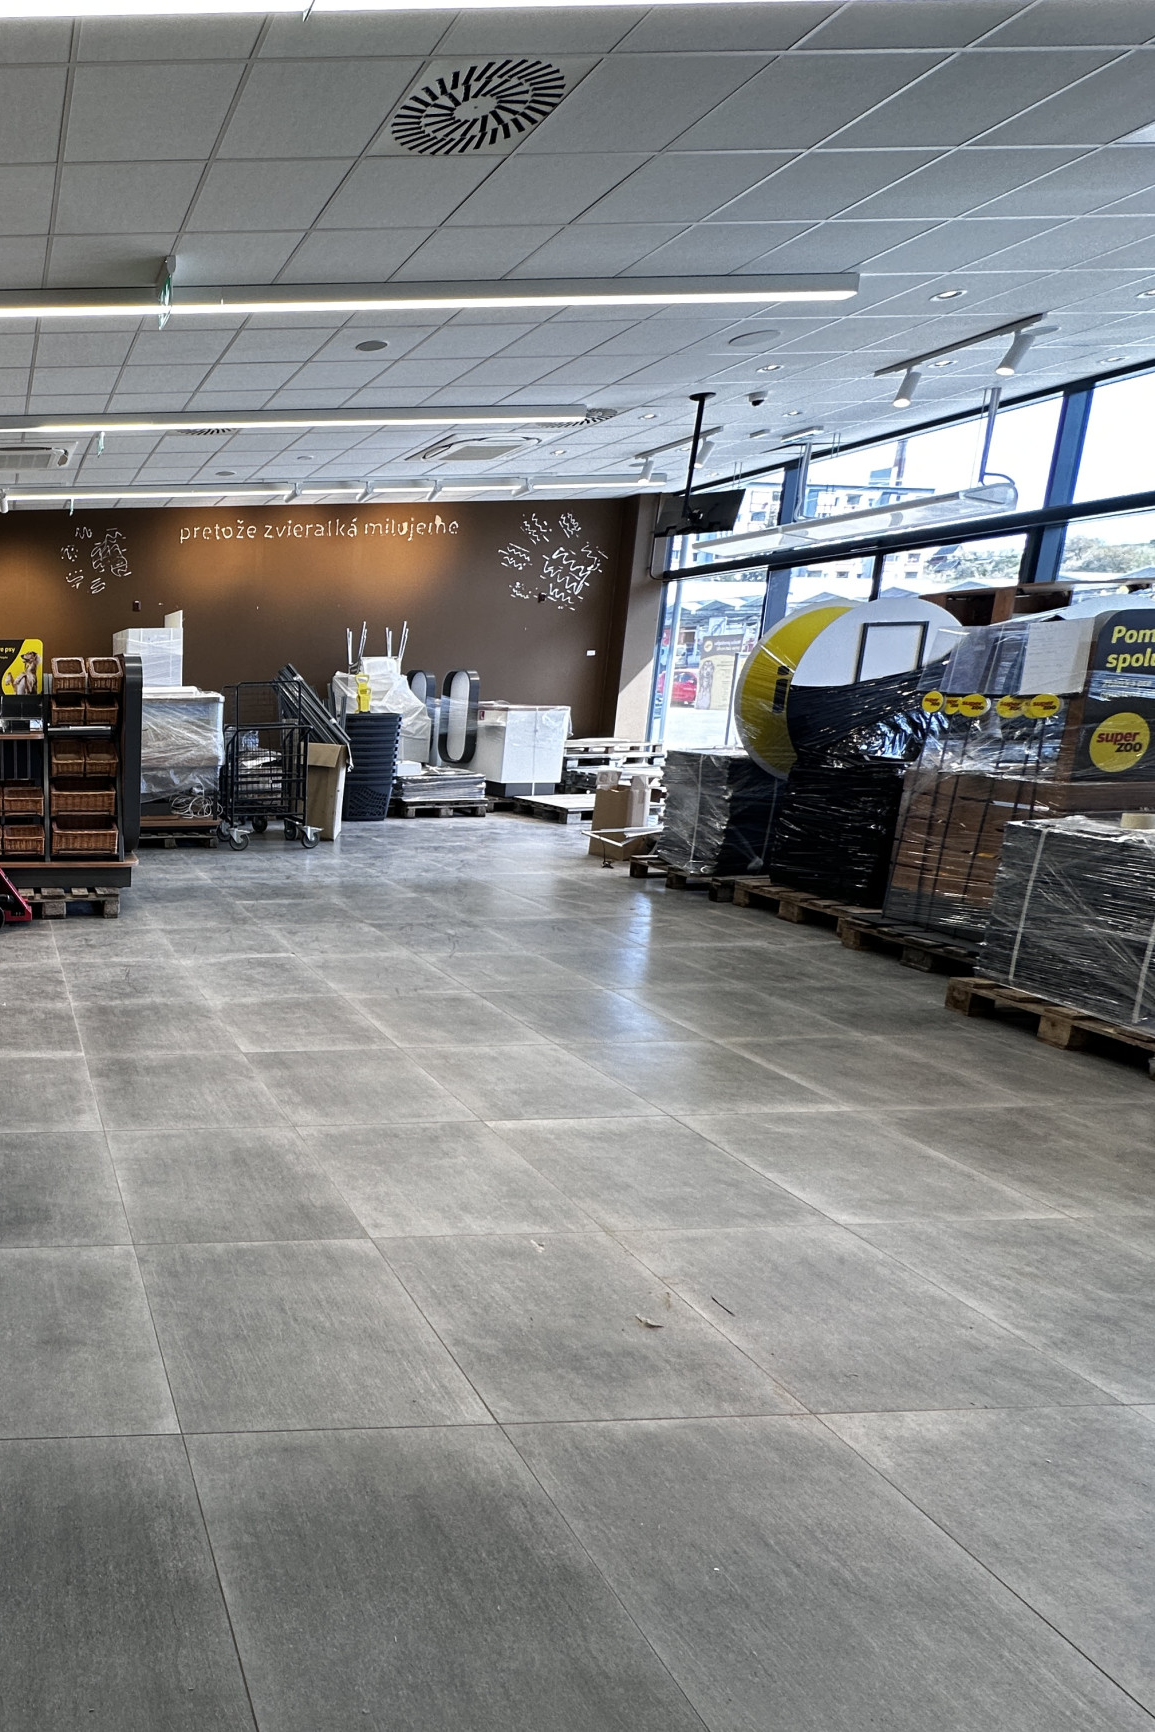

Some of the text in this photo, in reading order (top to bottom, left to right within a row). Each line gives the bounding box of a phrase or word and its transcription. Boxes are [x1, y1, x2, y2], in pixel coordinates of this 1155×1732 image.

[180, 519, 257, 544] pretože
[1096, 731, 1140, 745] super
[1115, 742, 1143, 752] zoo
